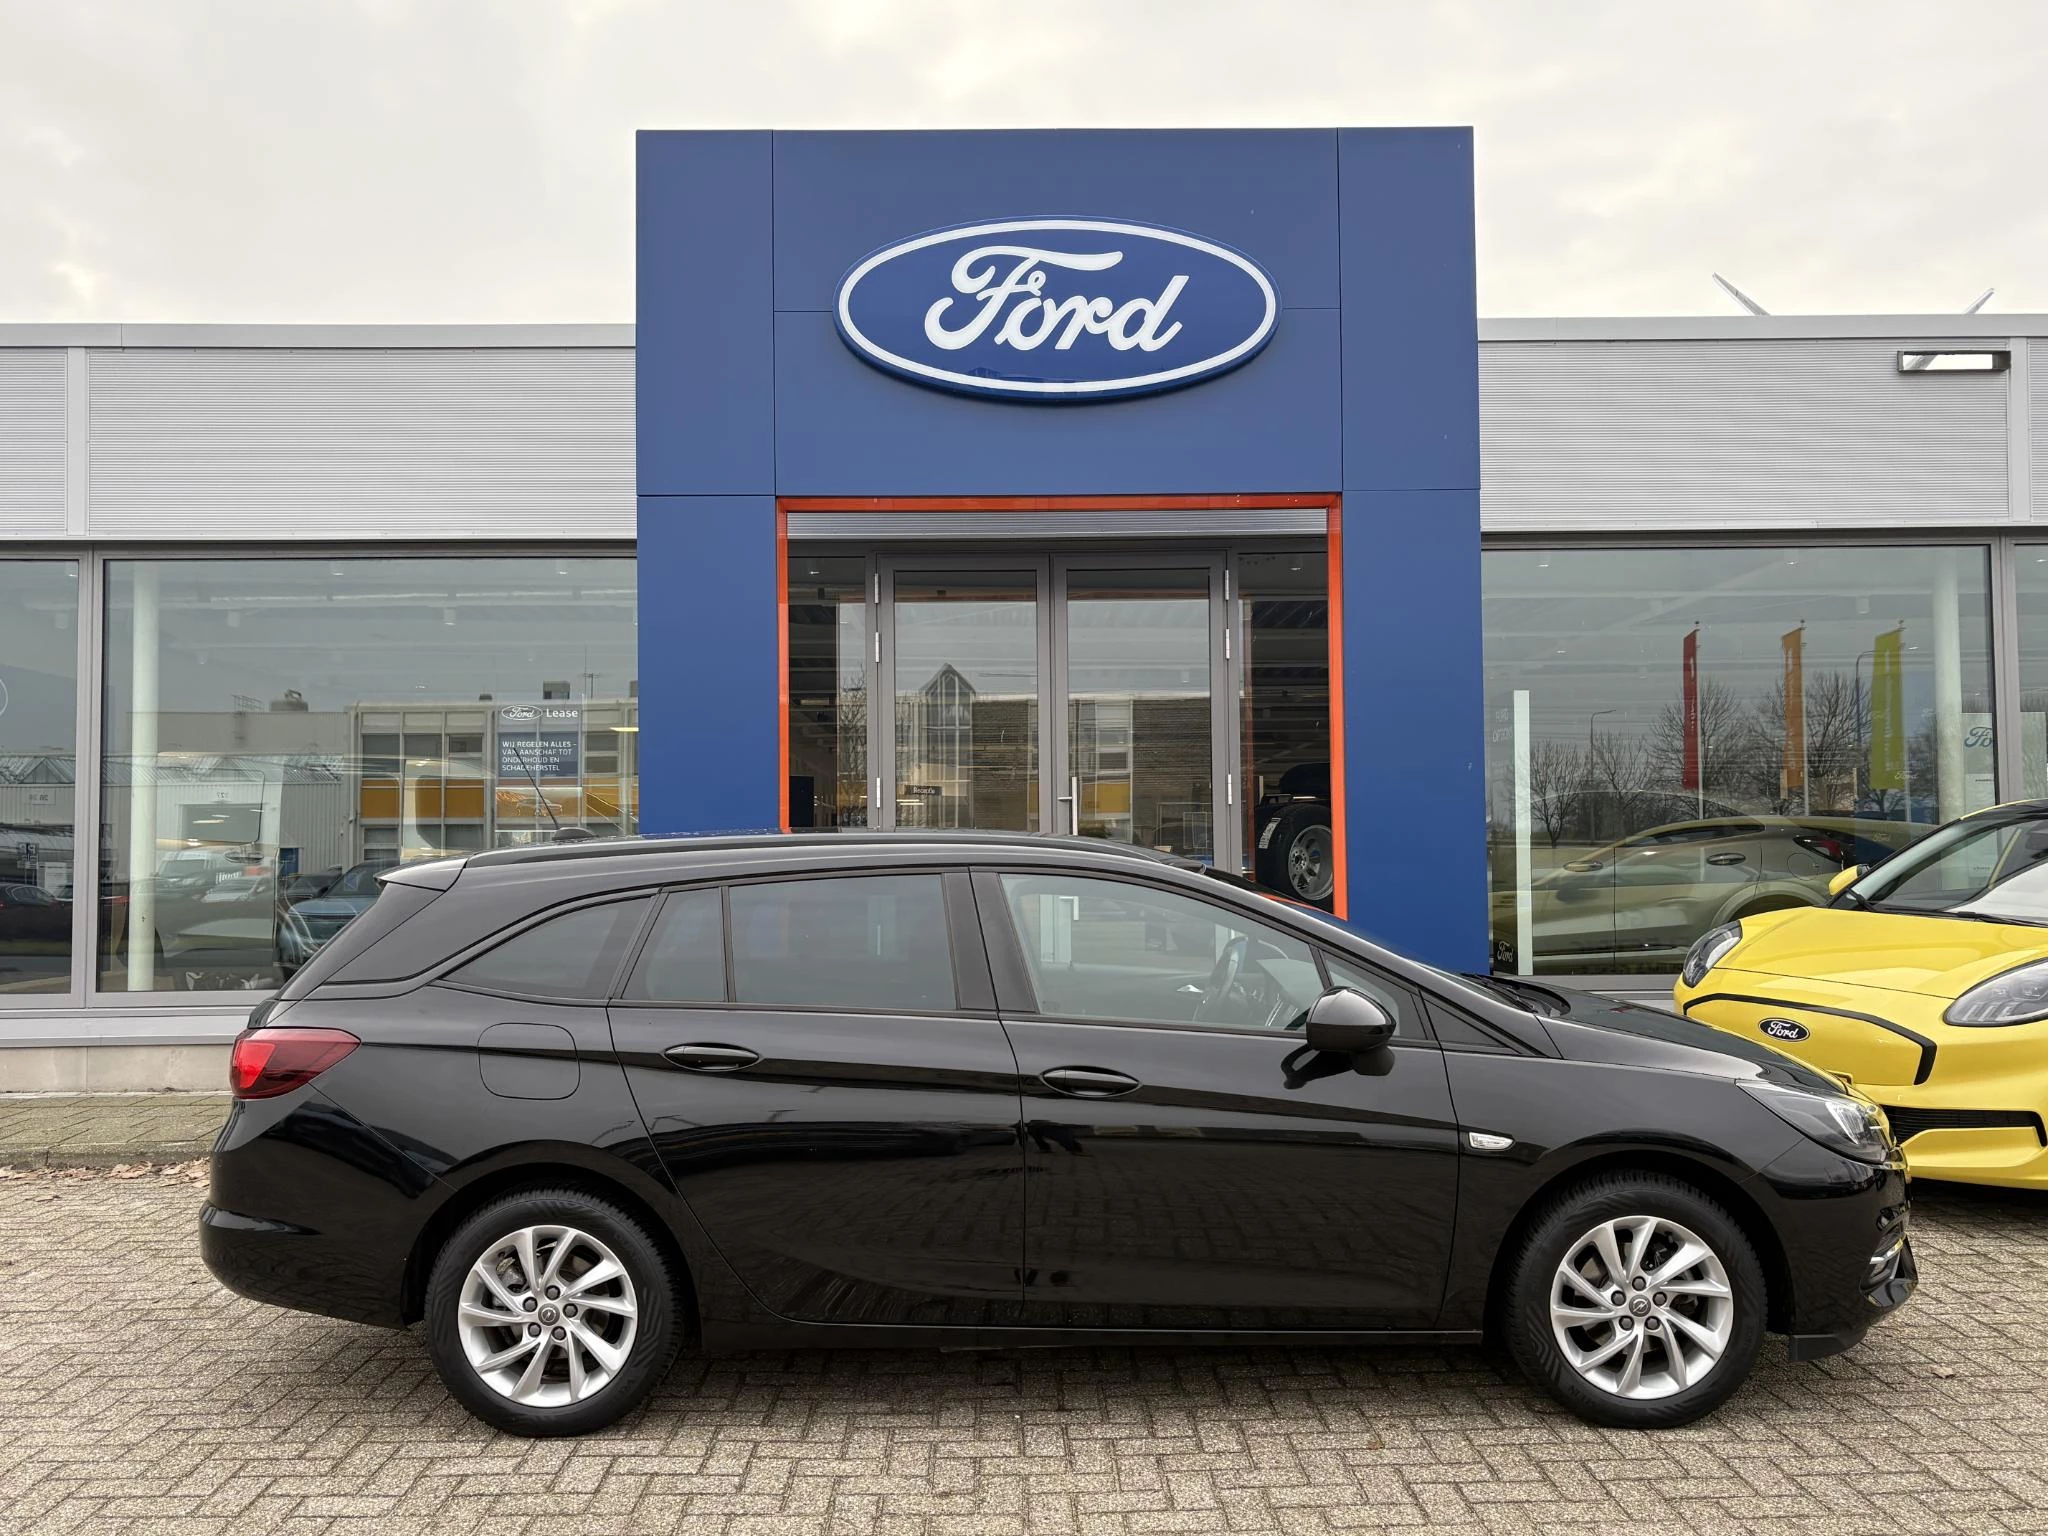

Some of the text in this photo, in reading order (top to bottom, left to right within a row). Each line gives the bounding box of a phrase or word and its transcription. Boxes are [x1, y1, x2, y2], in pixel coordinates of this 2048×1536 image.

[924, 245, 1190, 352] Ford
[509, 706, 579, 718] Ford Lease
[1964, 726, 1993, 748] Fo
[1768, 1021, 1799, 1038] Ford
